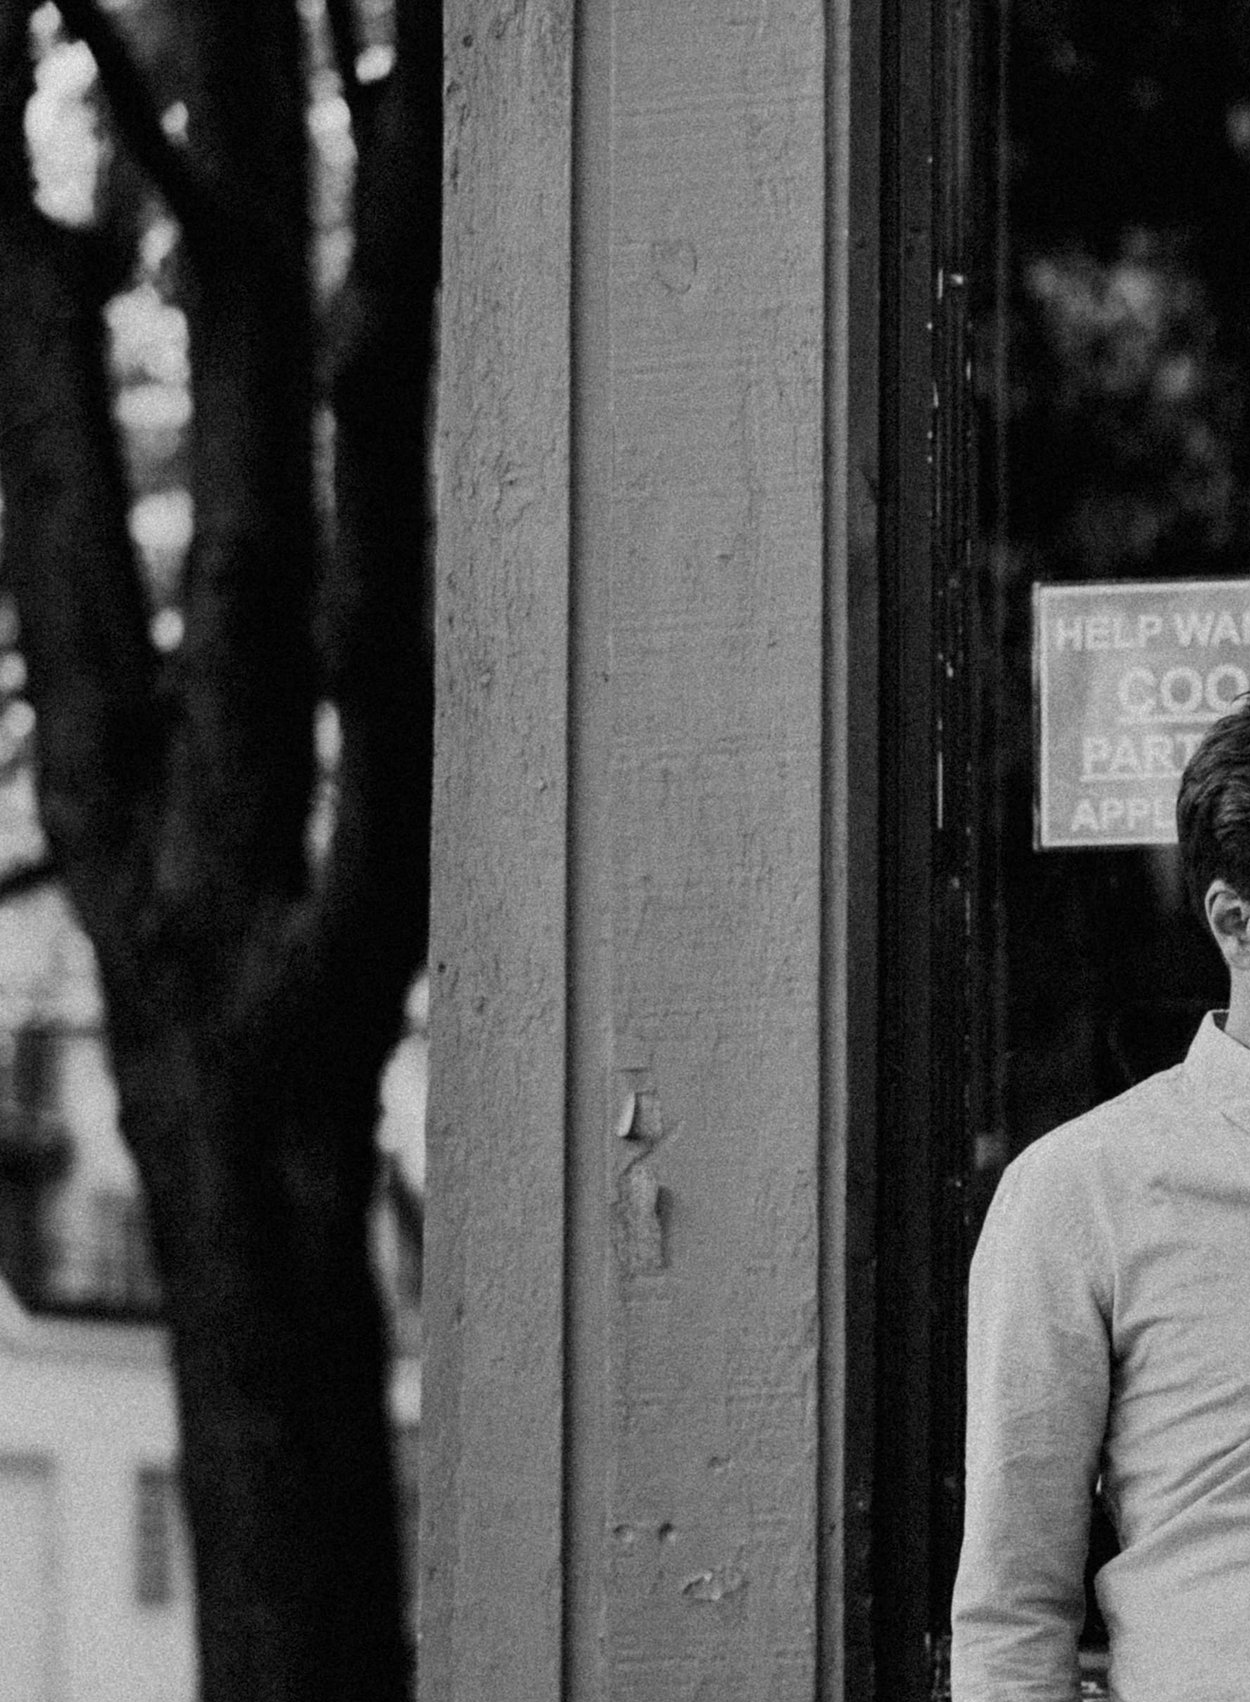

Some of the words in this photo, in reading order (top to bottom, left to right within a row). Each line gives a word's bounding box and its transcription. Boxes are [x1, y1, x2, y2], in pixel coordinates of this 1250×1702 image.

[1055, 612, 1163, 650] HELP
[1082, 731, 1205, 775] PART
[1071, 797, 1178, 833] APPL
